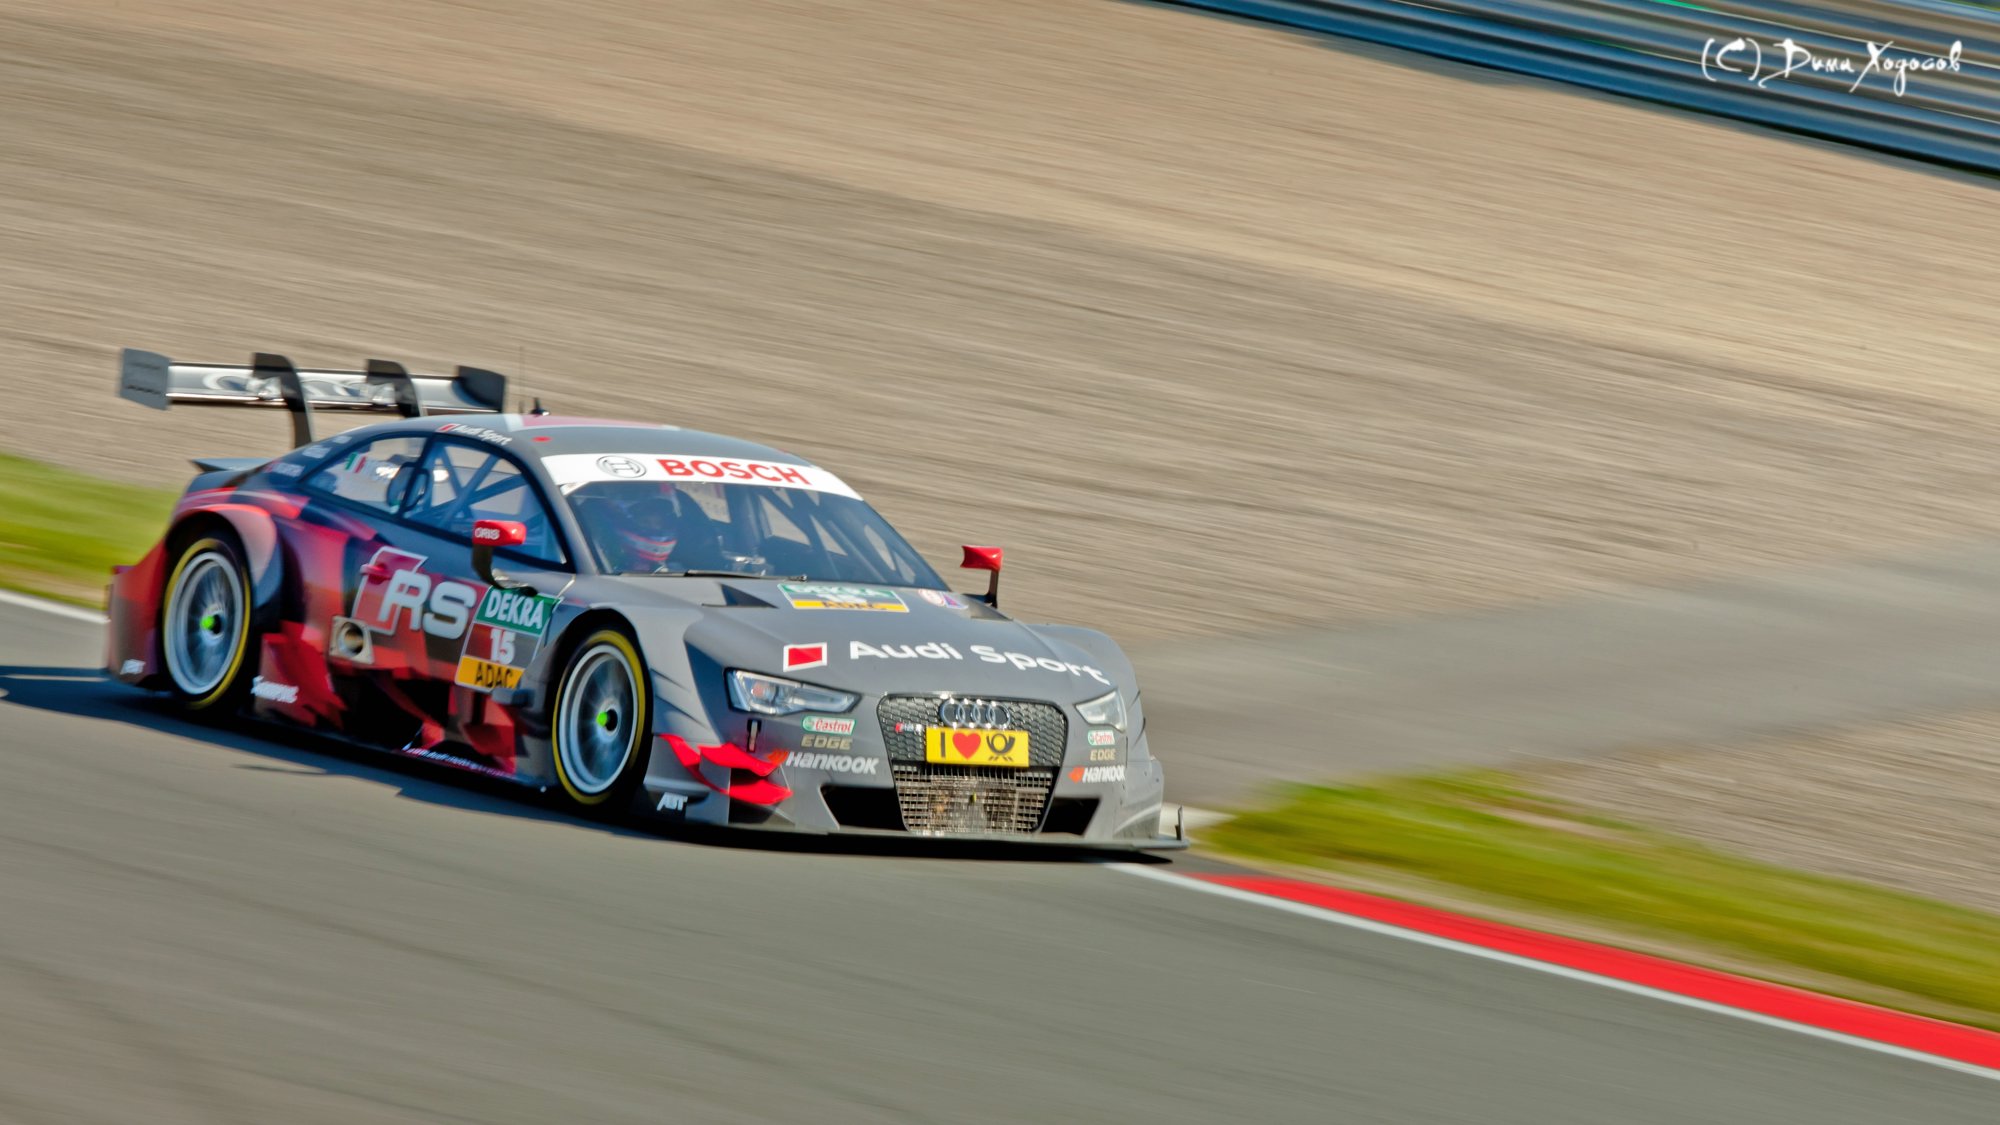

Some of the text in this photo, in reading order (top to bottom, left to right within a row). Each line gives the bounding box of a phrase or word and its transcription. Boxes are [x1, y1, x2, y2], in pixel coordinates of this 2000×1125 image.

[656, 459, 812, 486] BOSCH
[376, 569, 477, 640] RS
[484, 589, 545, 630] DEKRA
[490, 628, 516, 666] 15
[474, 661, 514, 689] ADAC
[849, 640, 1111, 686] Audi Sport
[815, 718, 852, 735] Castrol
[801, 734, 854, 751] EDGE
[939, 731, 947, 758] I
[1089, 748, 1117, 762] EDGE
